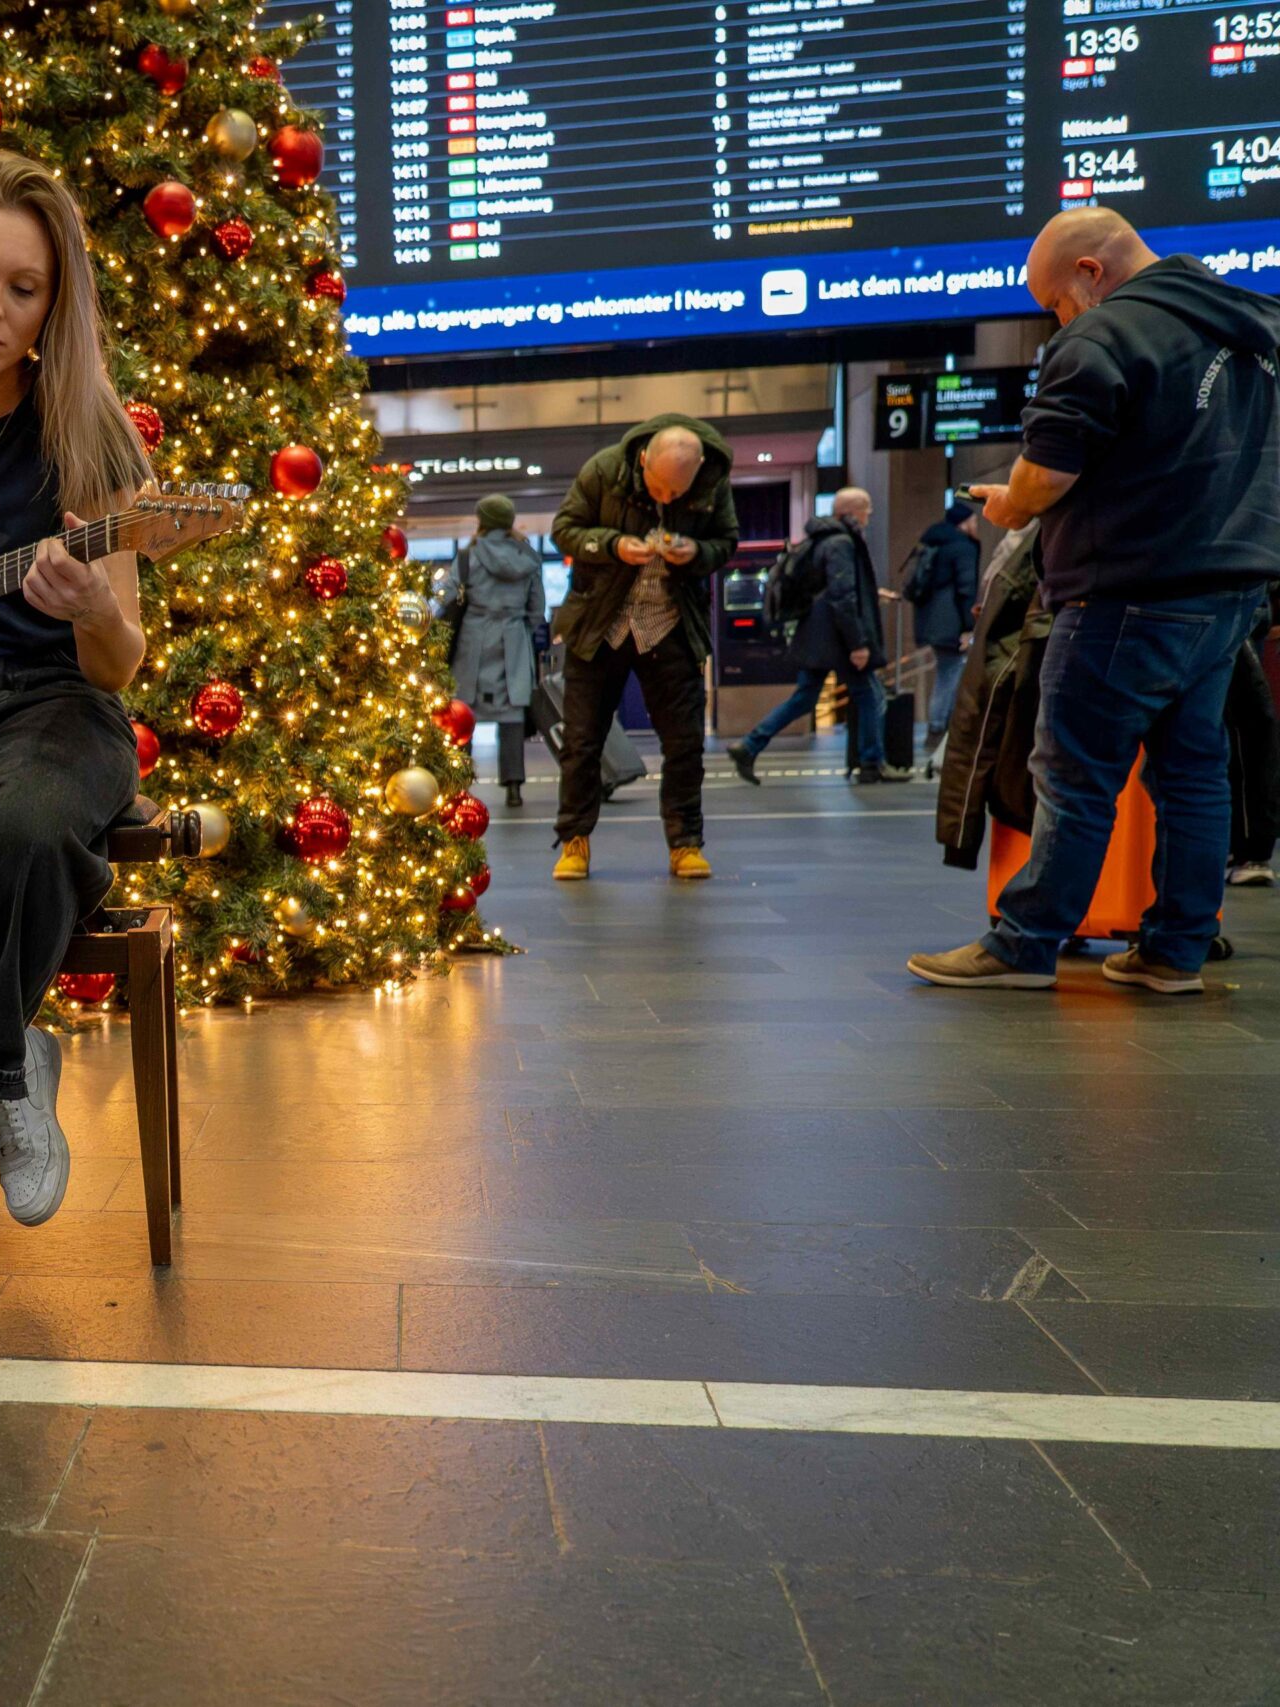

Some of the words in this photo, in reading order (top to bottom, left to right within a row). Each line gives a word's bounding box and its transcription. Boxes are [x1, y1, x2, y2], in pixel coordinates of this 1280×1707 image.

[1064, 25, 1139, 57] 13:36
[715, 49, 727, 65] 4
[476, 135, 508, 152] Oslo
[508, 131, 555, 150] Airport
[715, 137, 728, 153] 7
[392, 163, 428, 180] 14:11
[1063, 148, 1138, 178] 13:44
[392, 184, 428, 201] 14:11
[393, 205, 430, 222] 14:14
[712, 202, 730, 218] 11
[393, 226, 431, 243] 14:14
[819, 279, 860, 300] Last
[862, 274, 901, 297] den
[904, 270, 944, 294] ned
[946, 266, 1004, 295] gratis
[344, 313, 381, 336] deg
[382, 310, 416, 331] alle
[417, 304, 535, 331] togavganger
[537, 302, 563, 324] og
[565, 294, 673, 318] -ankomster
[684, 288, 745, 313] Norge
[886, 384, 911, 397] Spor
[889, 409, 909, 439] 9
[413, 457, 521, 474] Tickets
